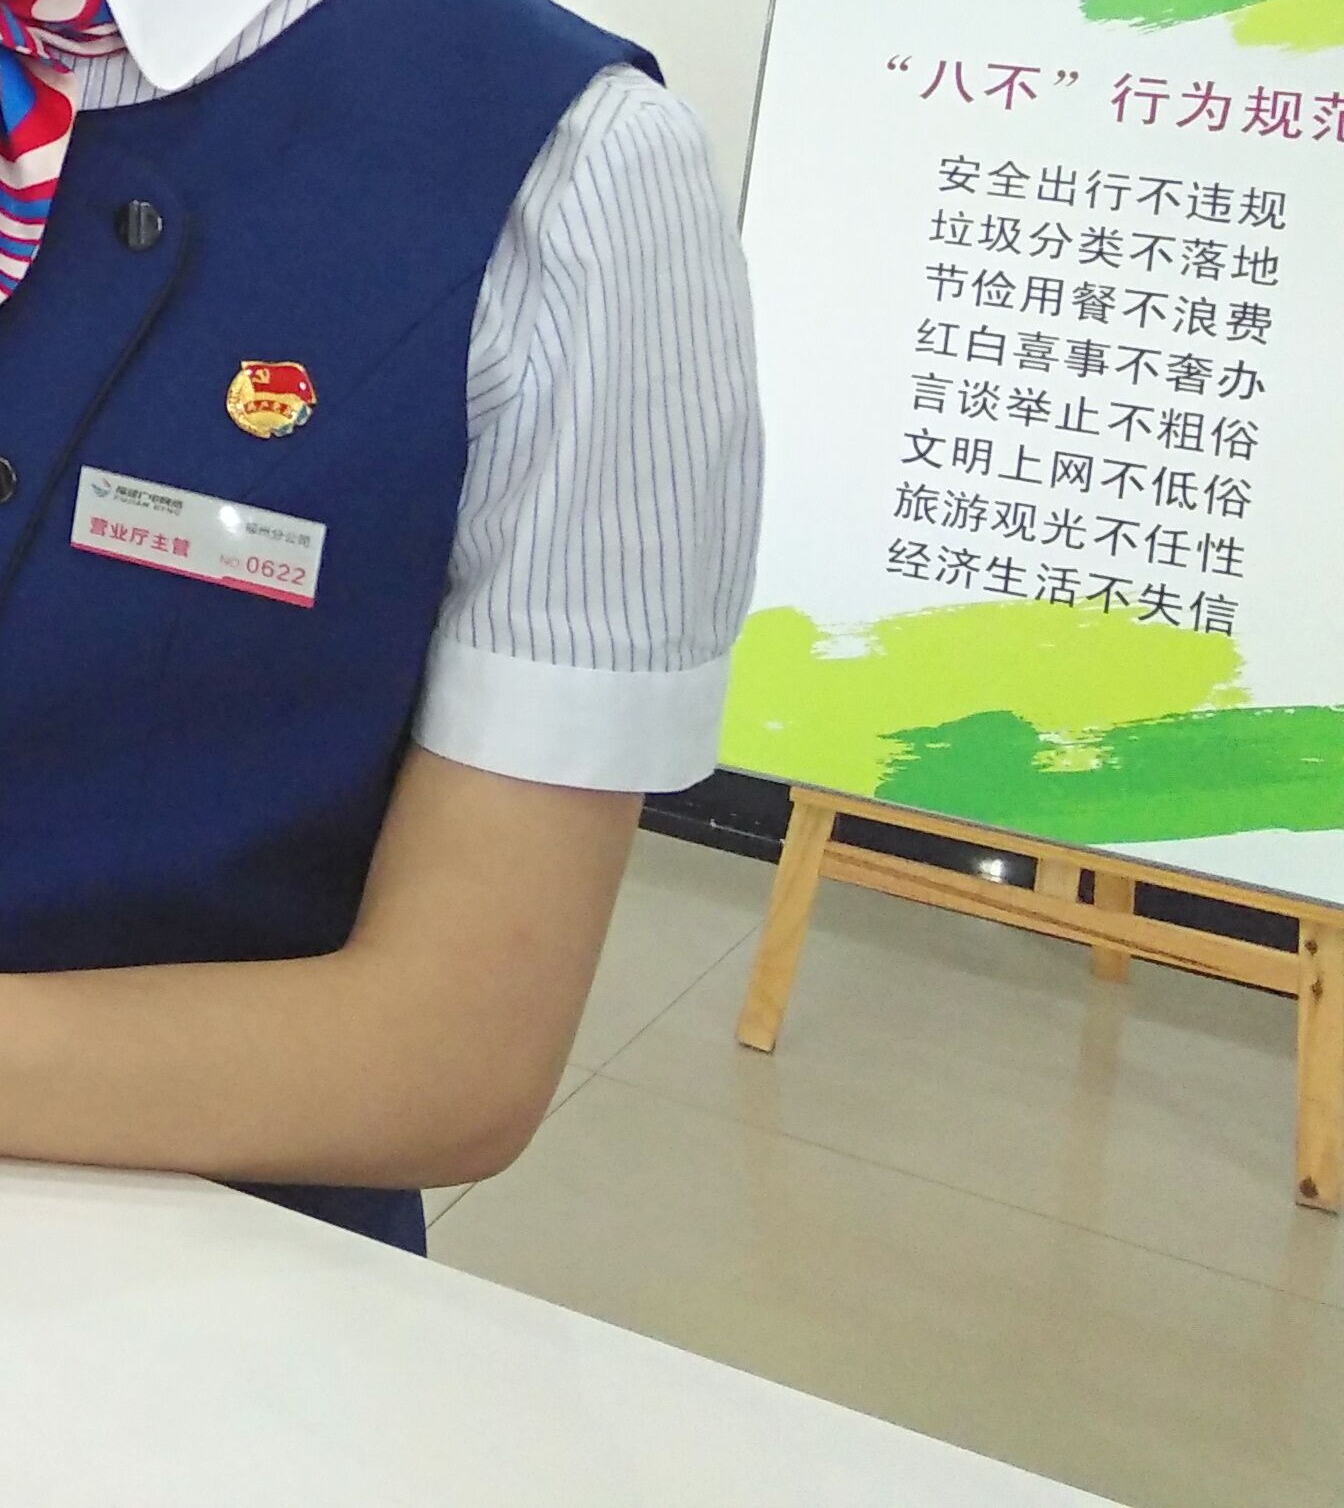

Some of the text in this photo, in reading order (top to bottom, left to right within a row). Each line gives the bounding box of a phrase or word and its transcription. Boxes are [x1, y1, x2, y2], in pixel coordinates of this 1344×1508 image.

[938, 154, 1287, 231] 安全出行不违规
[928, 209, 1281, 287] 垃圾分类不落地
[924, 262, 1274, 346] 节俭用餐不浪费
[914, 317, 1266, 401] 红白喜事不奢办
[910, 372, 1260, 461] 言谈举止不粗俗
[900, 427, 1253, 520] 文明上网不低俗
[88, 516, 191, 558] 营业厅主管
[244, 521, 311, 549] 福州分公司
[246, 556, 307, 586] 0622
[892, 481, 1245, 579] 旅游观光不任性
[885, 537, 1240, 636] 经济生活不失信
